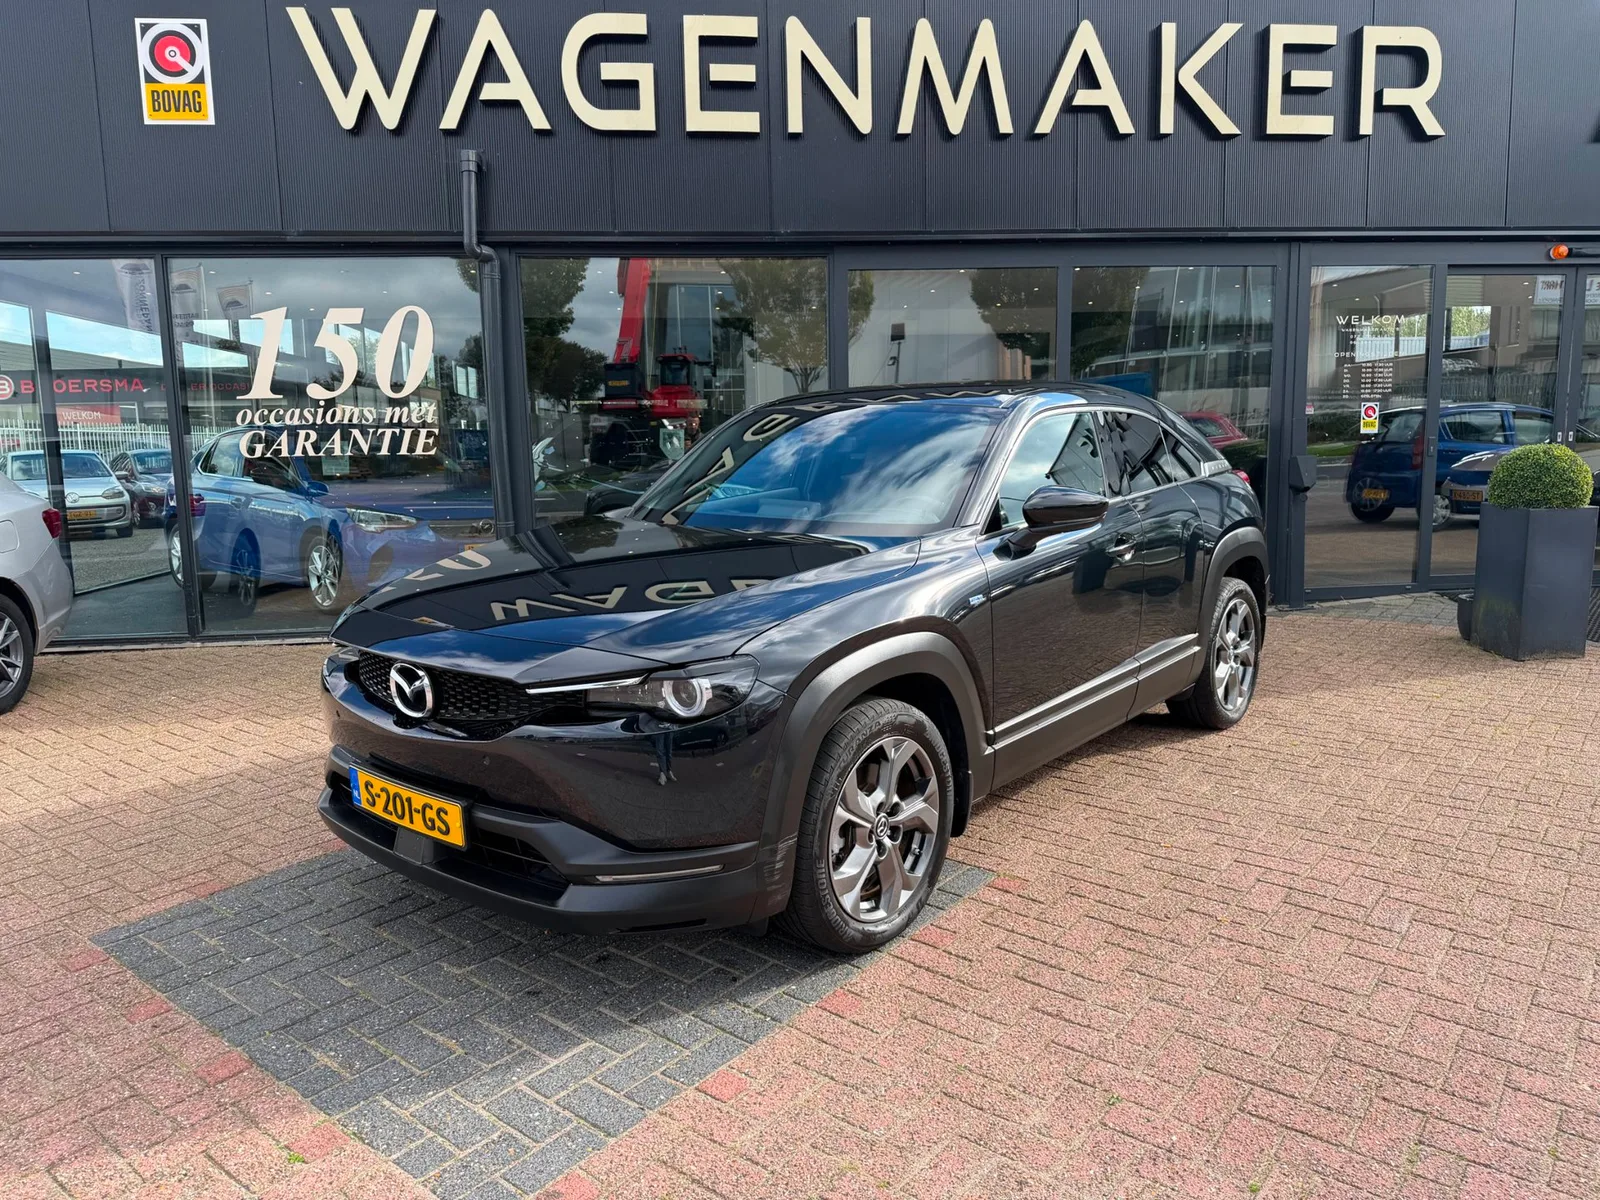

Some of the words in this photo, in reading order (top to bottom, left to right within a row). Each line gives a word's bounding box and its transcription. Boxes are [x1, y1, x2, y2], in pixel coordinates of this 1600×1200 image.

[286, 7, 1446, 137] WAGENMAKER
[151, 90, 202, 113] BOVAG
[1335, 314, 1406, 326] WELKOM
[236, 305, 434, 400] 150
[21, 379, 144, 394] BOERSMA
[62, 411, 101, 420] WELKOM
[236, 400, 374, 426] occasions
[384, 402, 438, 424] met
[239, 428, 439, 459] GARANTIE
[364, 780, 450, 836] S-201-GS
